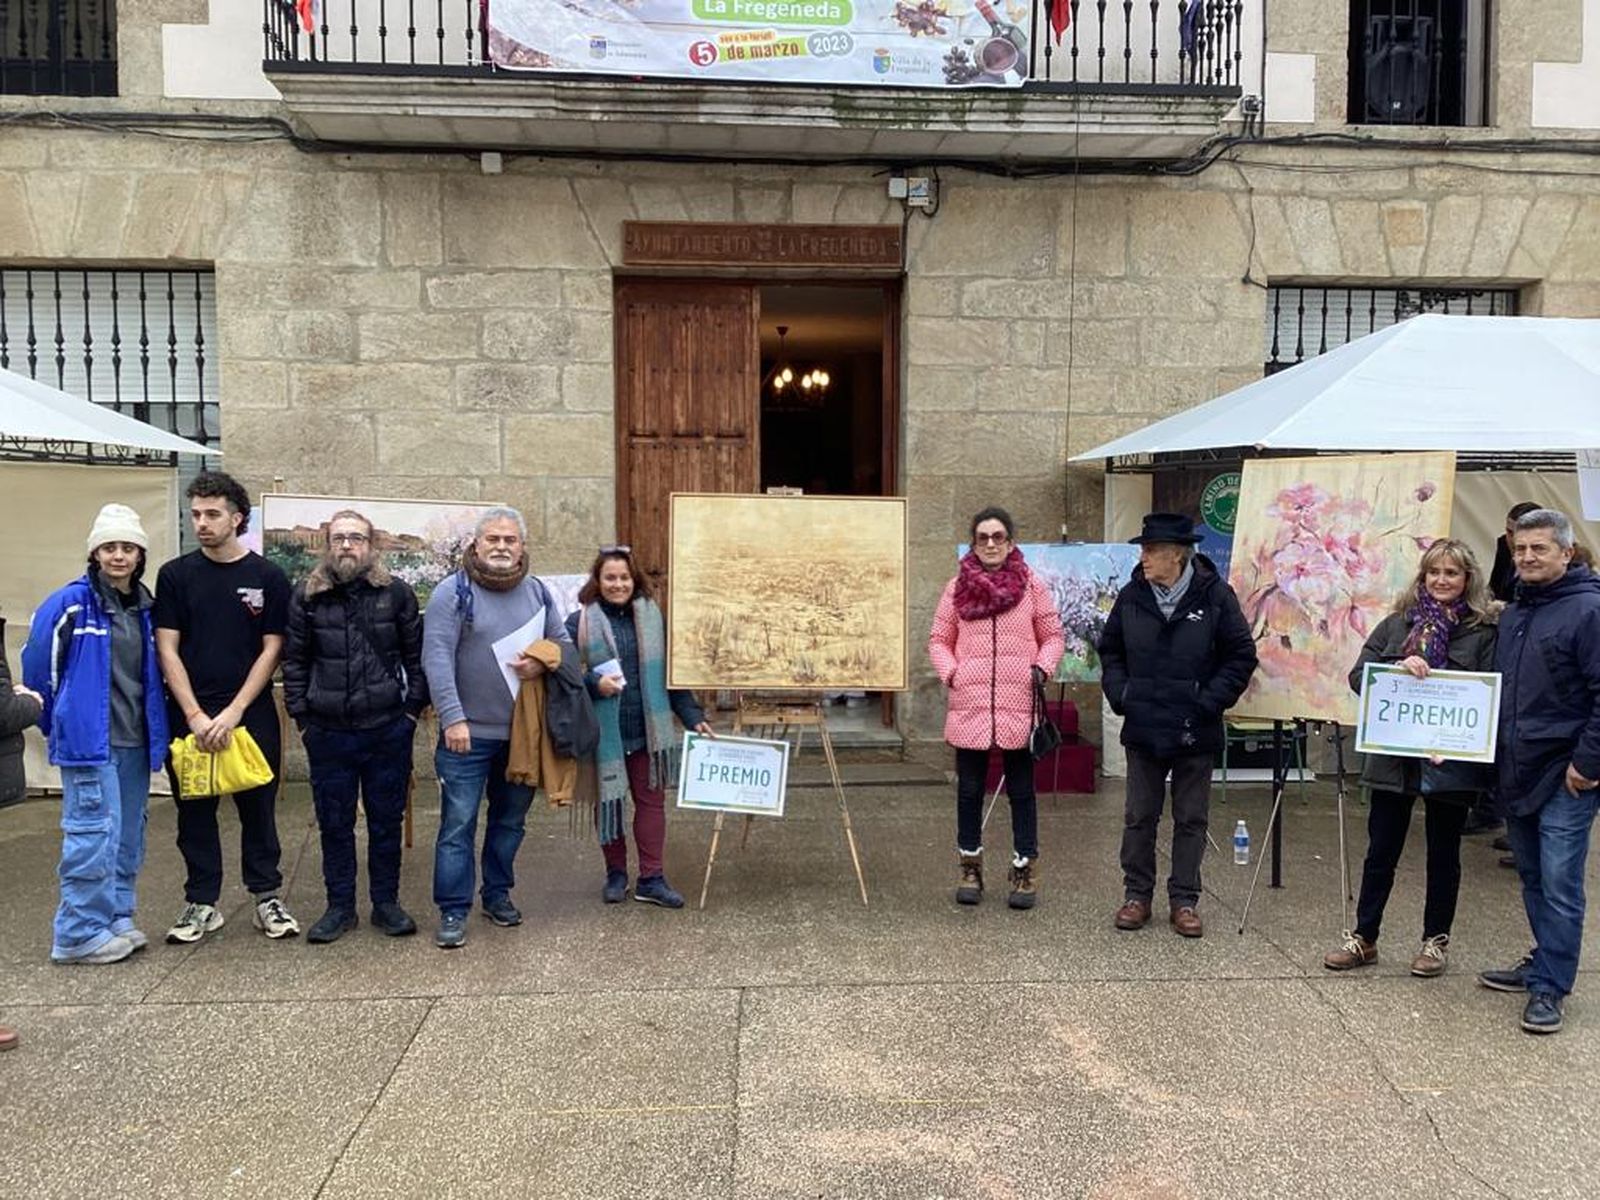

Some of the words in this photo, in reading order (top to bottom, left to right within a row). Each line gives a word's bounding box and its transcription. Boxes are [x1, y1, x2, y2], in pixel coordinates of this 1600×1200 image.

[705, 0, 726, 13] La
[734, 0, 842, 19] Fregeneda
[696, 42, 714, 65] 5
[727, 44, 746, 61] de
[749, 42, 800, 60] marzo
[813, 35, 849, 51] 2023
[1397, 701, 1479, 729] PREMIO
[707, 764, 771, 788] PREMIO
